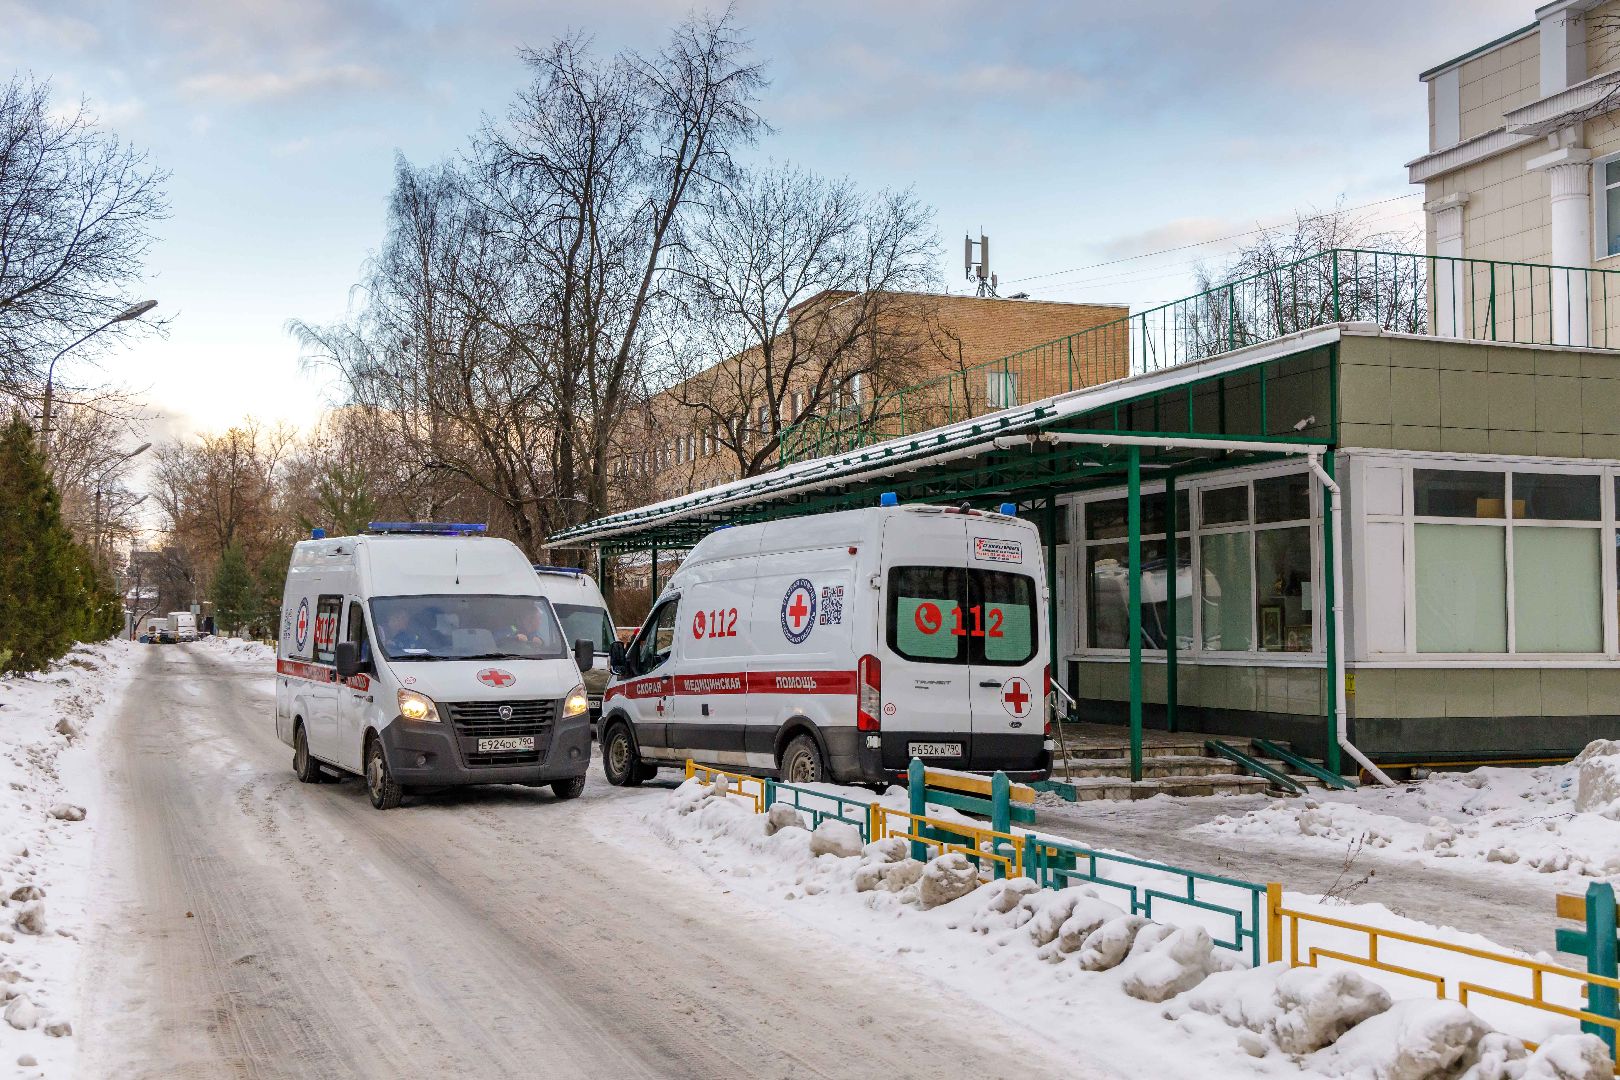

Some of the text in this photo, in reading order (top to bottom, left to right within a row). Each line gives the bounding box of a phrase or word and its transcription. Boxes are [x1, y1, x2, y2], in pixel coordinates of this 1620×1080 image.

[319, 617, 335, 644] 112
[709, 607, 738, 638] 112
[950, 604, 1004, 638] 112
[636, 676, 817, 695] СКОРАЯ МЕДИЦИНСКАЯ ПОМОЩЬ
[911, 744, 946, 755] Р652КА
